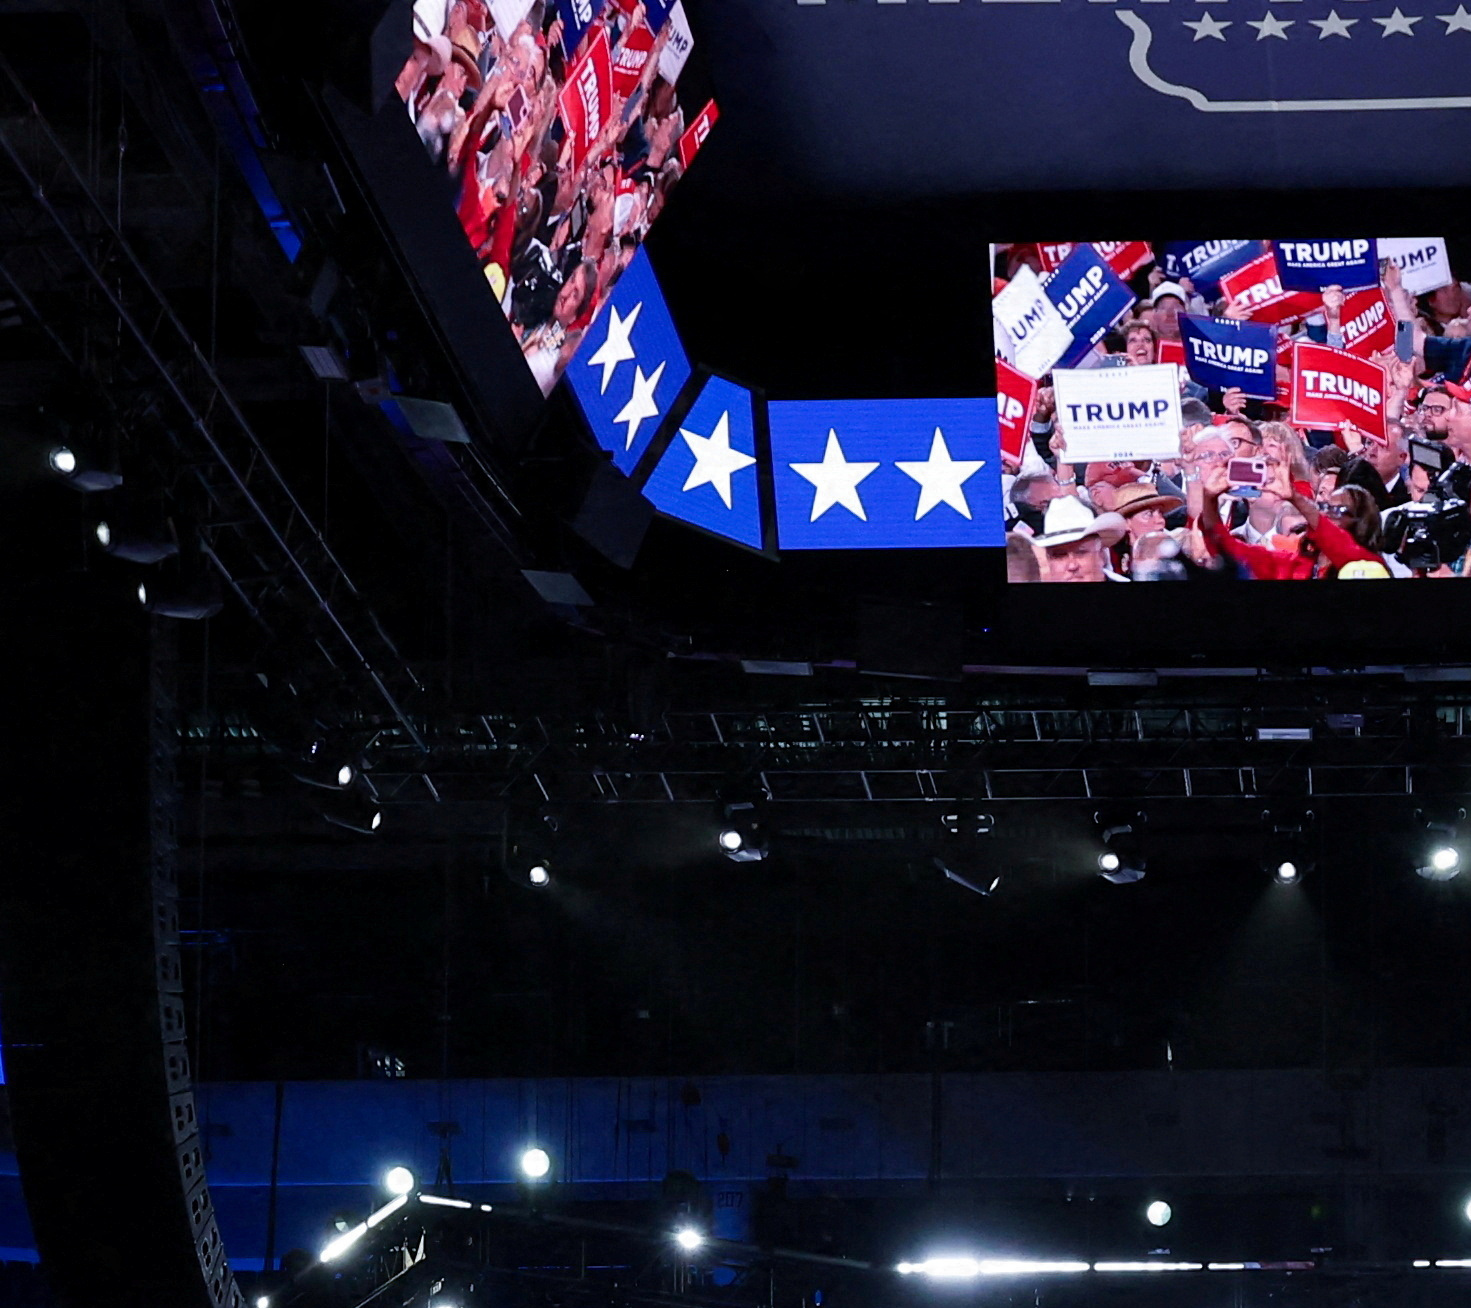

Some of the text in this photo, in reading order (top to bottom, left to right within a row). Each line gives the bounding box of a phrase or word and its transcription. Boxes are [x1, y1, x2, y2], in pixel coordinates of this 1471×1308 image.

[578, 58, 599, 141] TRUMP
[1279, 241, 1369, 263] TRUMP
[1188, 338, 1269, 369] TRUMP
[1301, 370, 1382, 406] TRUMP
[1067, 399, 1169, 422] TRUMP
